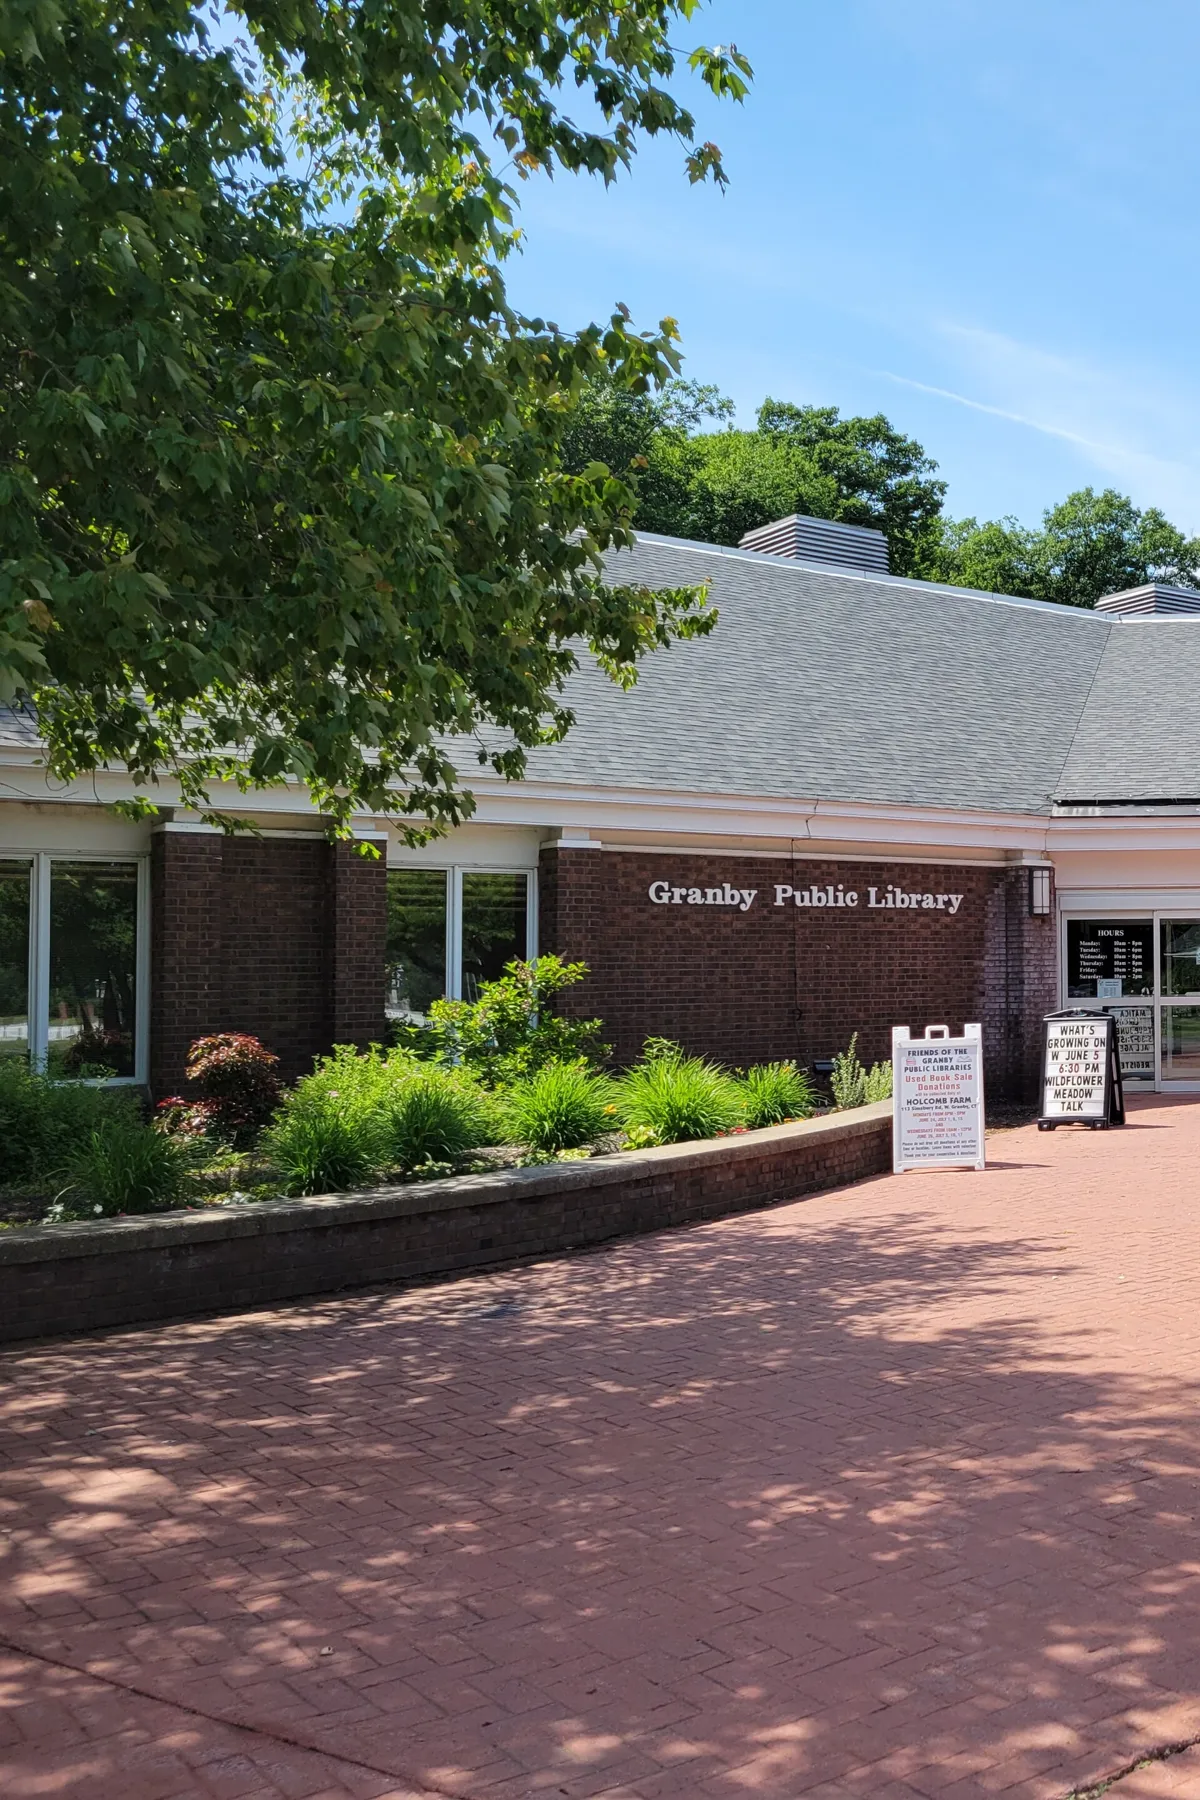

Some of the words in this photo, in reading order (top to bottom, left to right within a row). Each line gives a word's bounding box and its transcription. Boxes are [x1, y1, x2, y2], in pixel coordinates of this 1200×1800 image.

[648, 881, 758, 911] Granby
[774, 884, 858, 907] Public
[867, 884, 964, 914] Library
[1060, 1026, 1095, 1035] WHAT'S
[1048, 1038, 1089, 1048] GROWING
[1094, 1038, 1106, 1047] ON
[1052, 1051, 1059, 1060] W
[1066, 1051, 1088, 1060] JUNE
[1094, 1051, 1099, 1060] 5
[1059, 1063, 1079, 1073] 6:30
[1085, 1063, 1099, 1073] PM
[1045, 1076, 1102, 1086] WILDFLOWER
[1054, 1089, 1093, 1099] MEADOW
[1061, 1102, 1083, 1111] TALK
